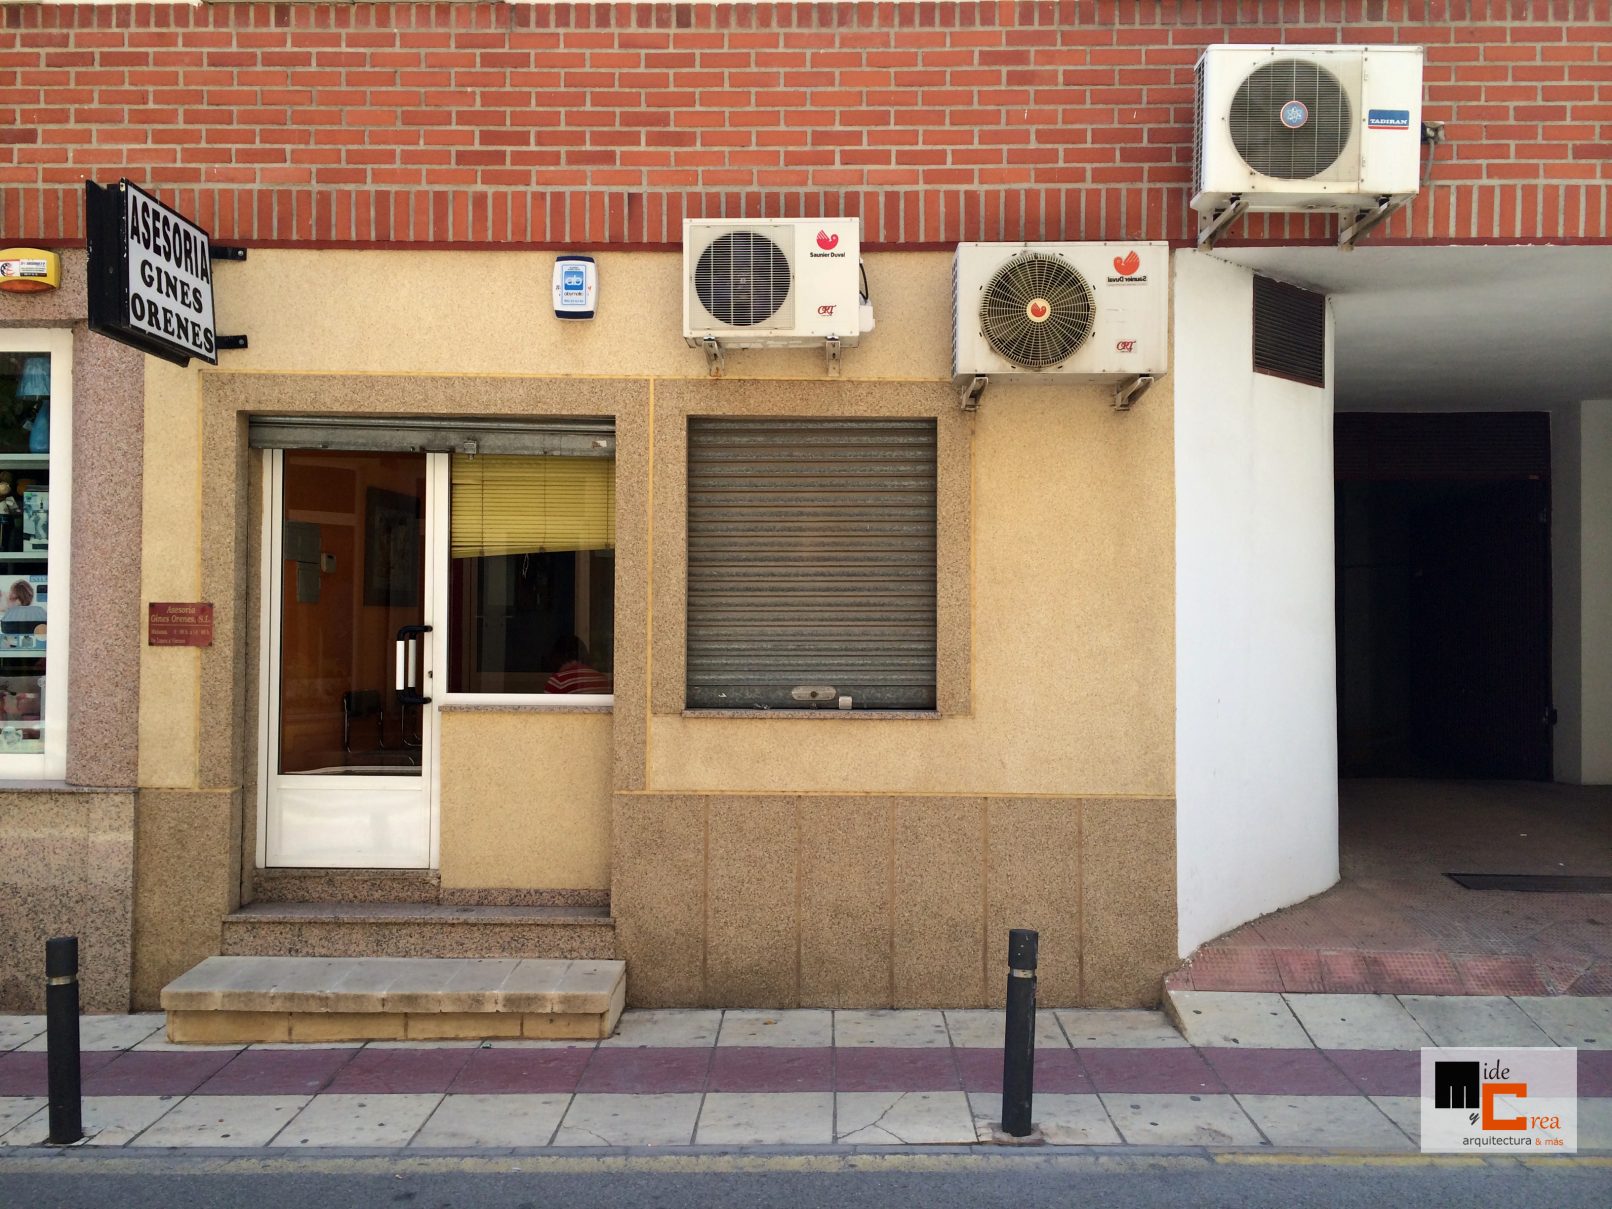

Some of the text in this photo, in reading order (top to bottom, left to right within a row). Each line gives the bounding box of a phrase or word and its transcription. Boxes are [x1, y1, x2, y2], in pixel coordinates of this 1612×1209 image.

[130, 194, 210, 285] ASESORIA
[140, 259, 203, 314] GINES
[130, 292, 214, 354] ORENES
